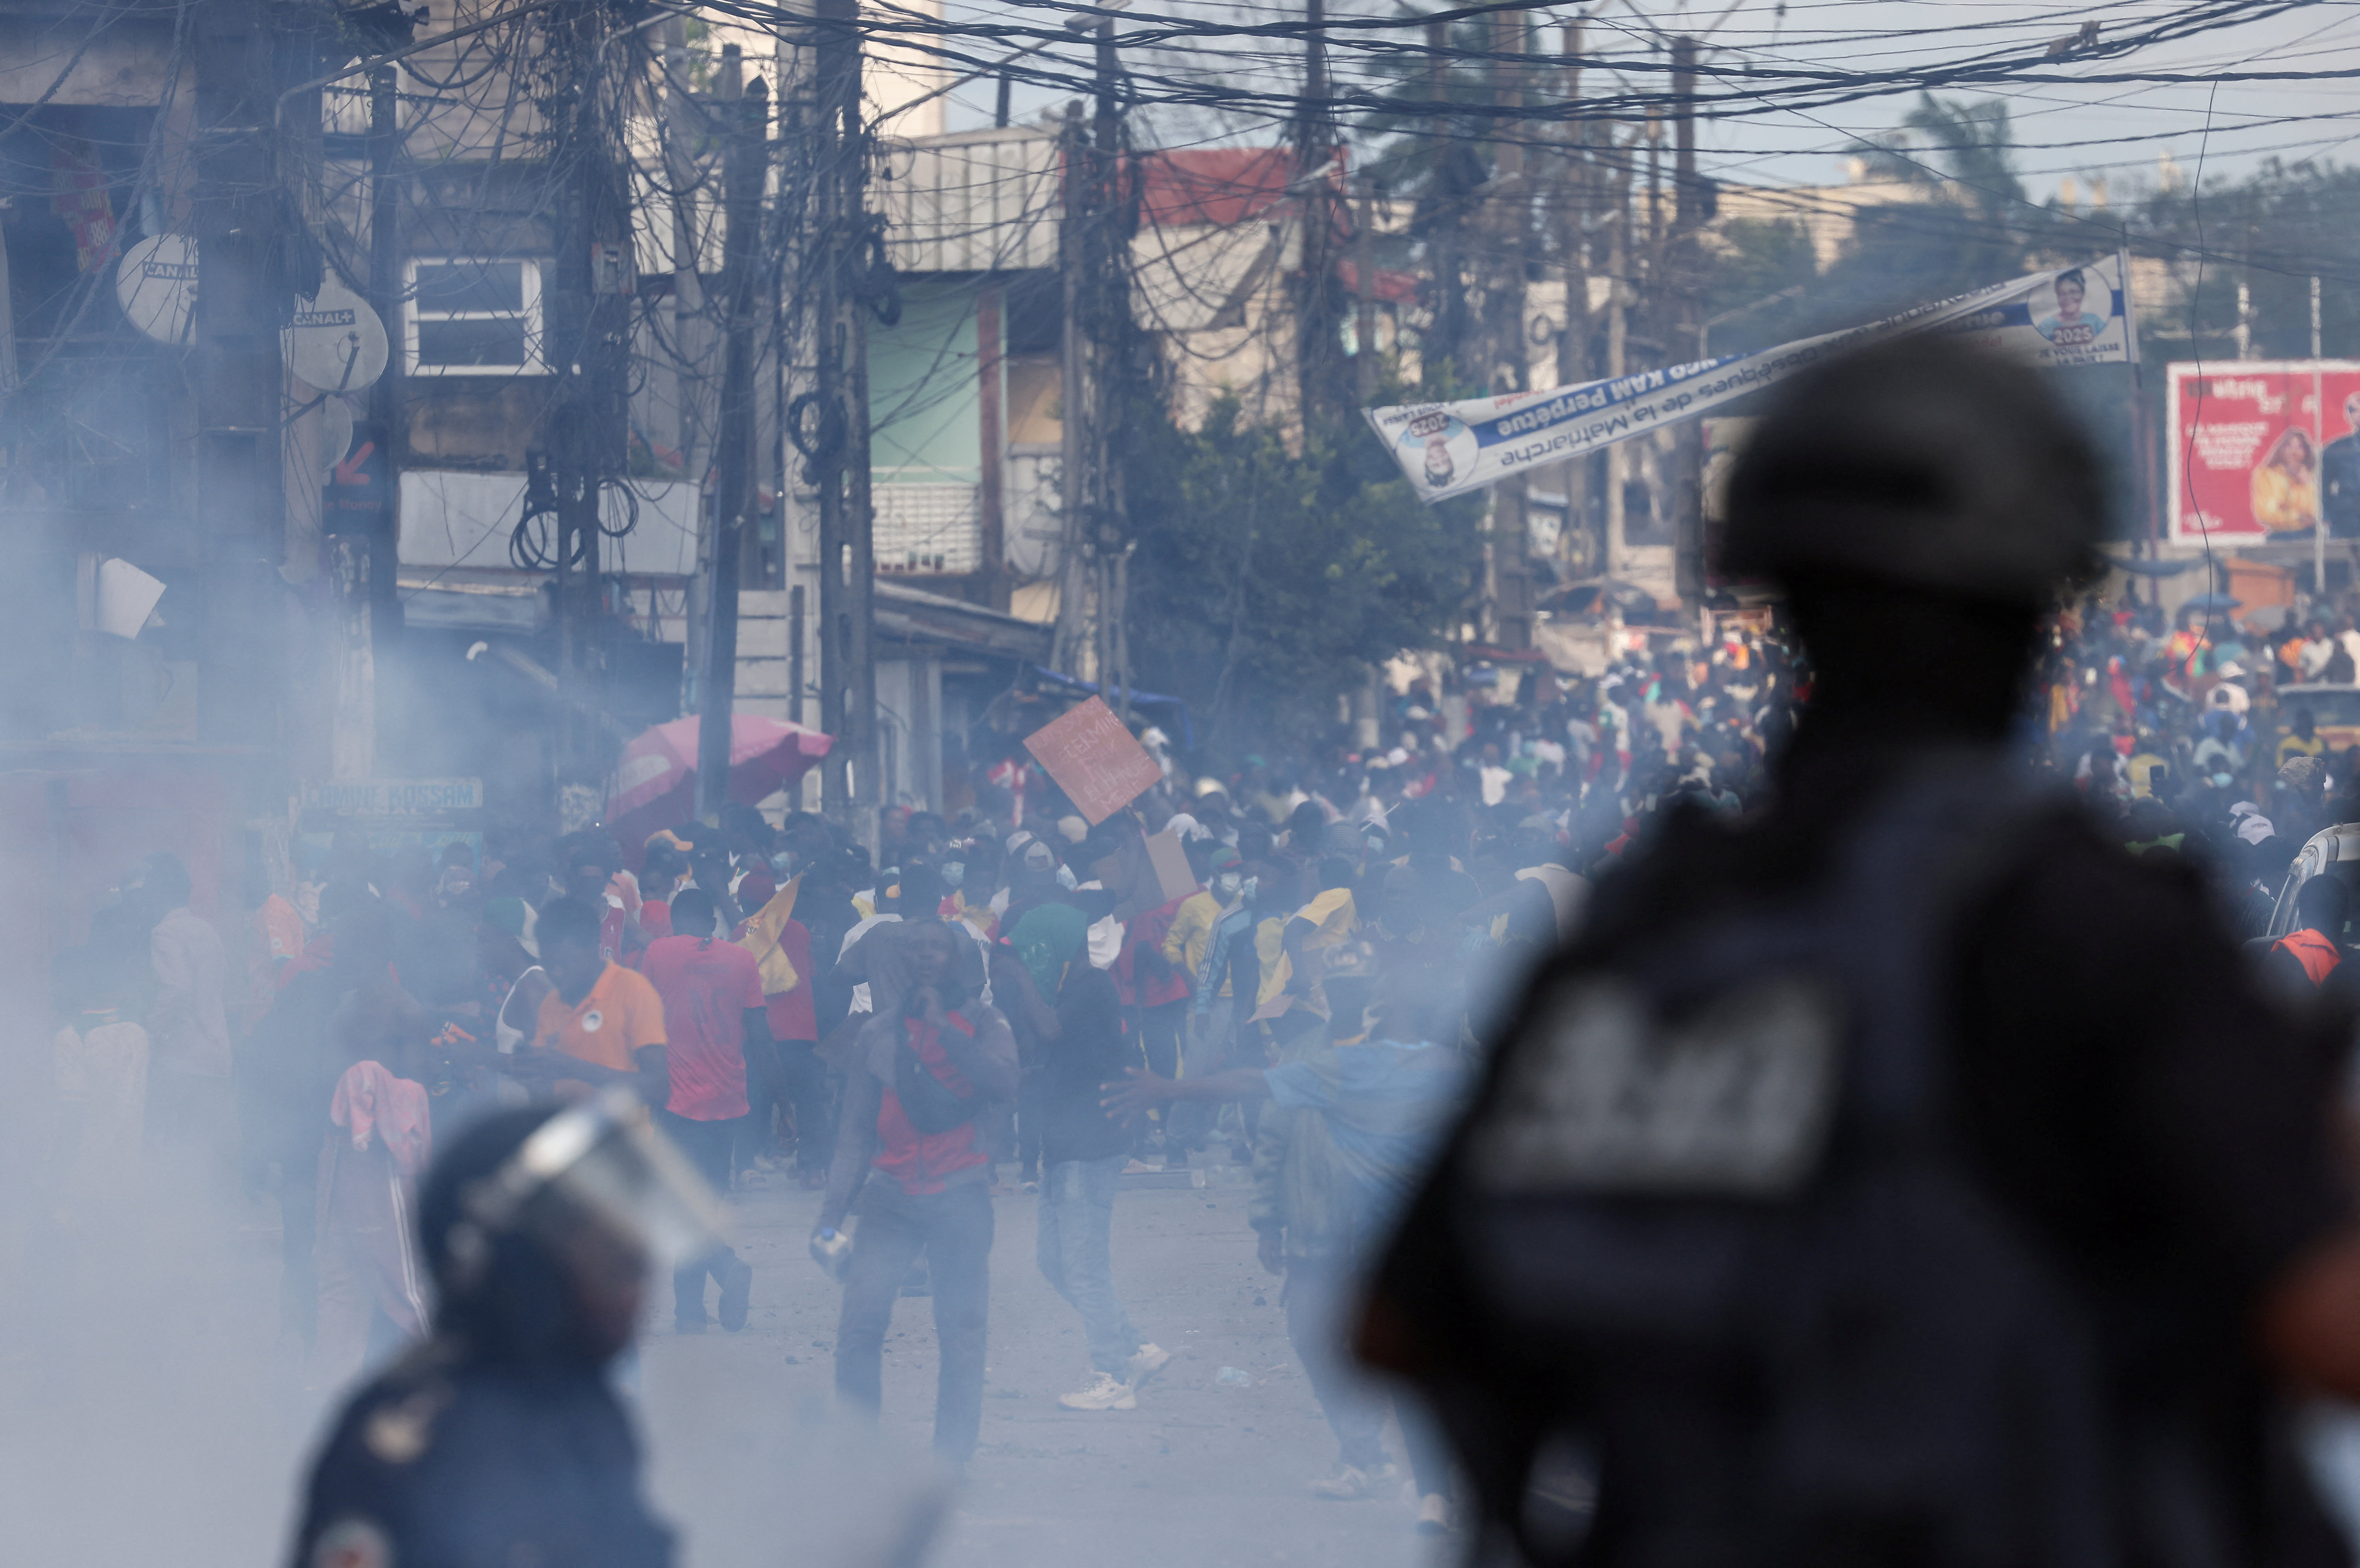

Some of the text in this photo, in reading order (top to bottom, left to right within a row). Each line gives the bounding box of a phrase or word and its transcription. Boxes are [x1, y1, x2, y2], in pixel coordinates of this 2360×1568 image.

[293, 312, 352, 325] CANAL+
[2054, 327, 2093, 343] 2025
[1496, 387, 1607, 436] Perpétue
[1662, 392, 1692, 412] de
[1633, 405, 1657, 422] la
[1501, 415, 1629, 466] Matriarche
[389, 785, 474, 806] KOSSAM
